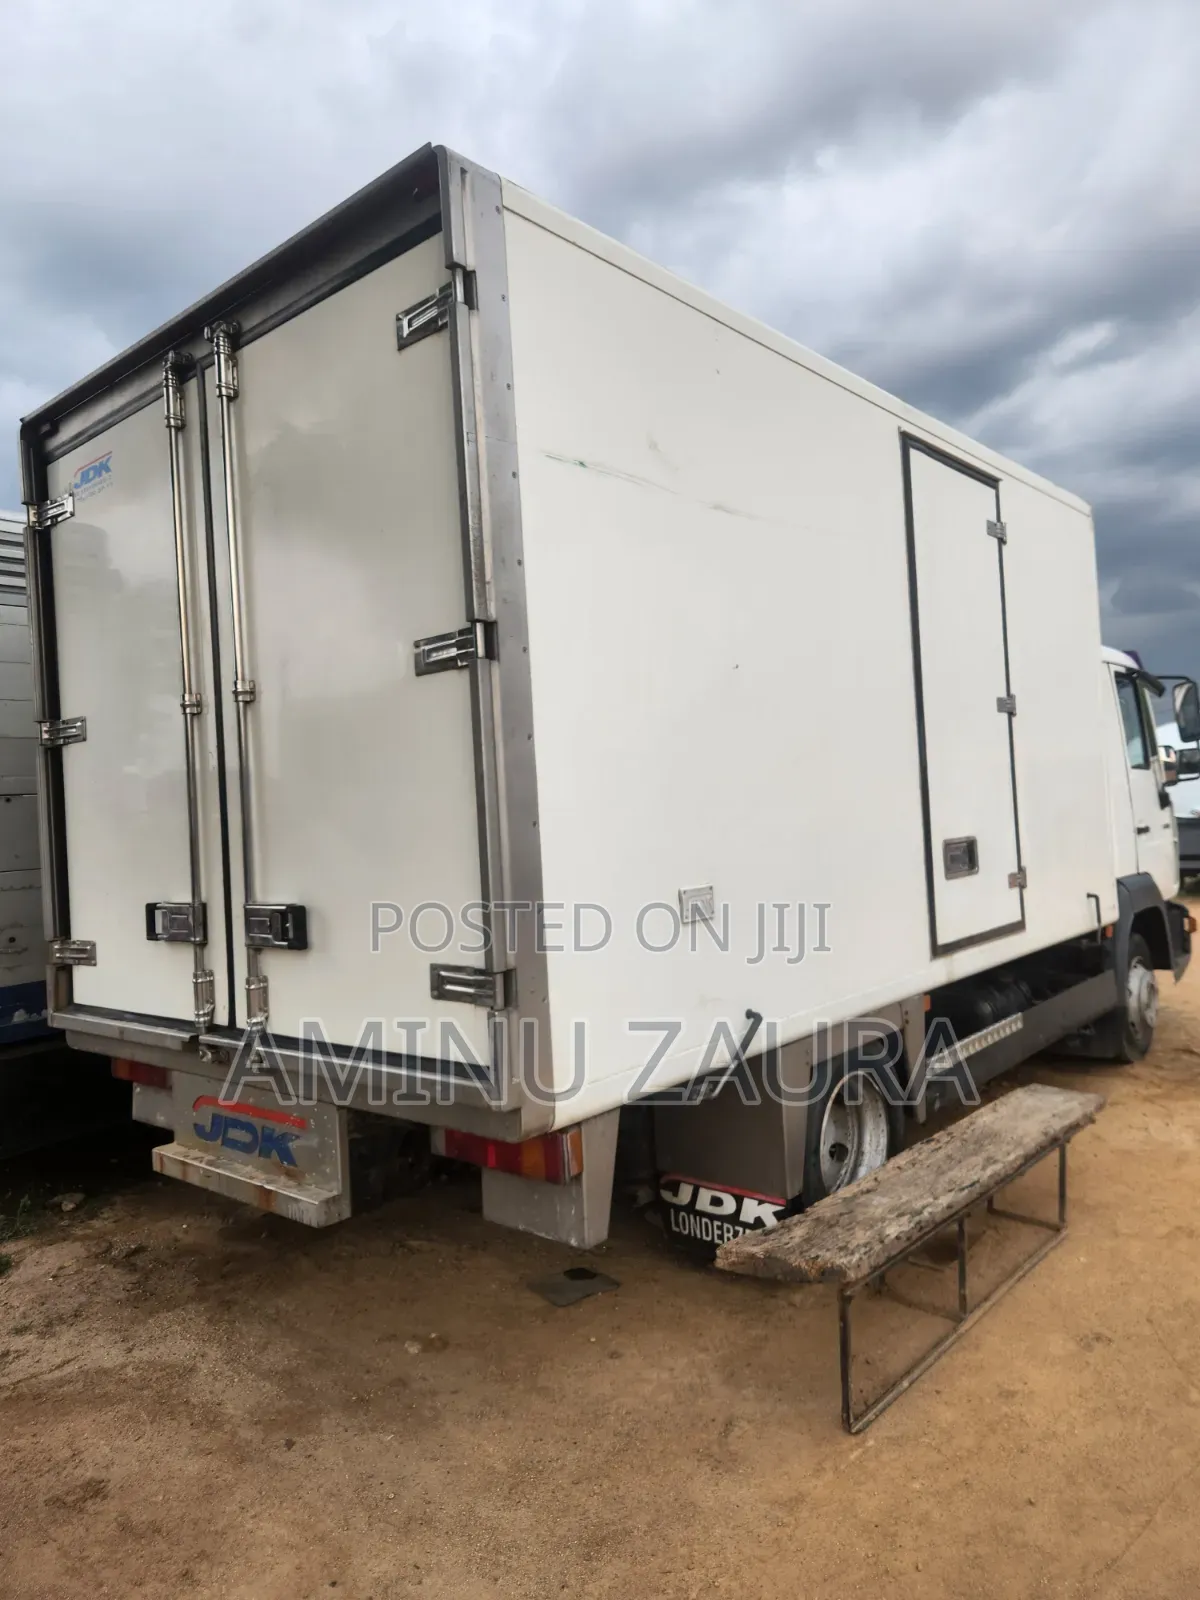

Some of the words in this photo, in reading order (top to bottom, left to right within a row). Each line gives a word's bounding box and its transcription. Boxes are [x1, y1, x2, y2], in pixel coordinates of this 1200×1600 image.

[73, 455, 112, 489] JDK
[193, 1113, 301, 1168] JDK
[659, 1182, 786, 1228] JDK
[670, 1208, 752, 1245] LONDERZ
